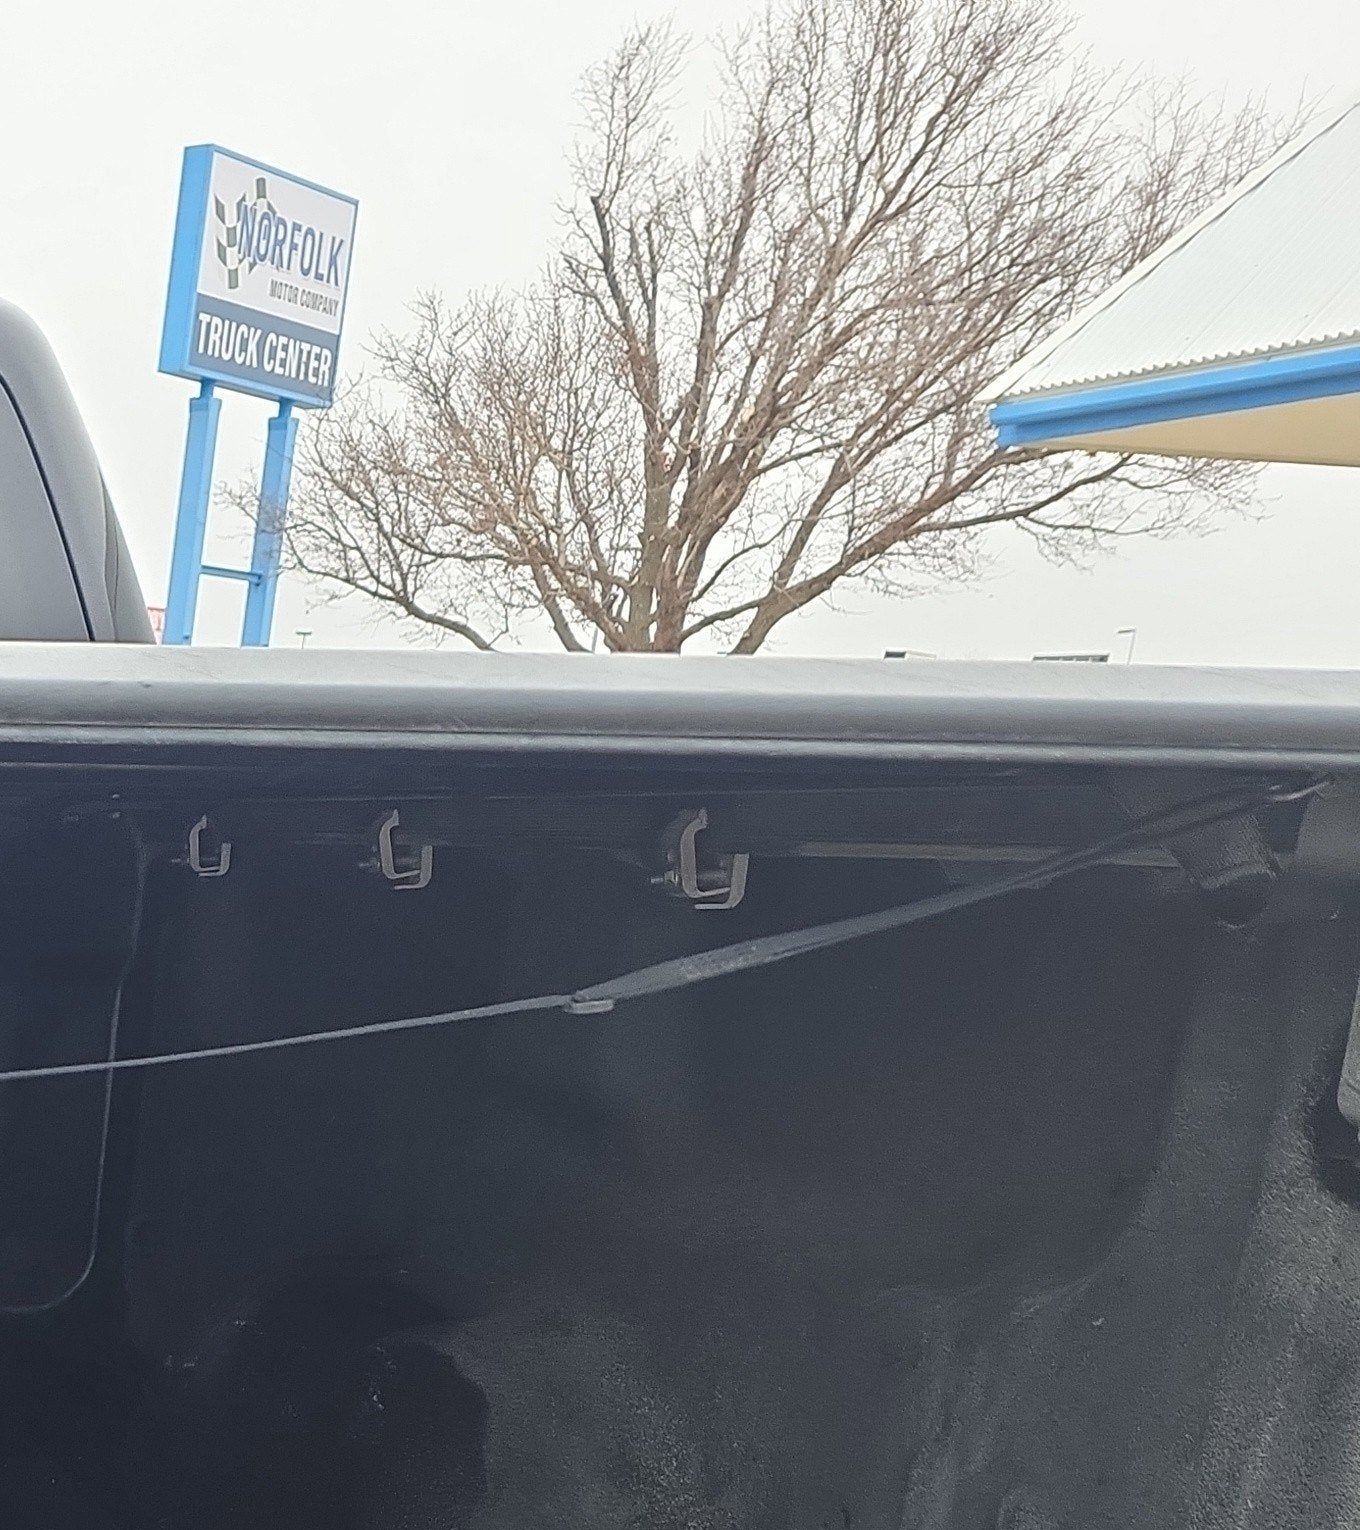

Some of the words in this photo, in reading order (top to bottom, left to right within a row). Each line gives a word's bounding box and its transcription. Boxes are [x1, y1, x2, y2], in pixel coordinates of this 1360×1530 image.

[237, 203, 344, 286] NORFOLK
[269, 277, 298, 306] MOTOR
[299, 289, 339, 318] COMPANY
[197, 312, 262, 368] TRUCK
[262, 332, 333, 387] CENTER
